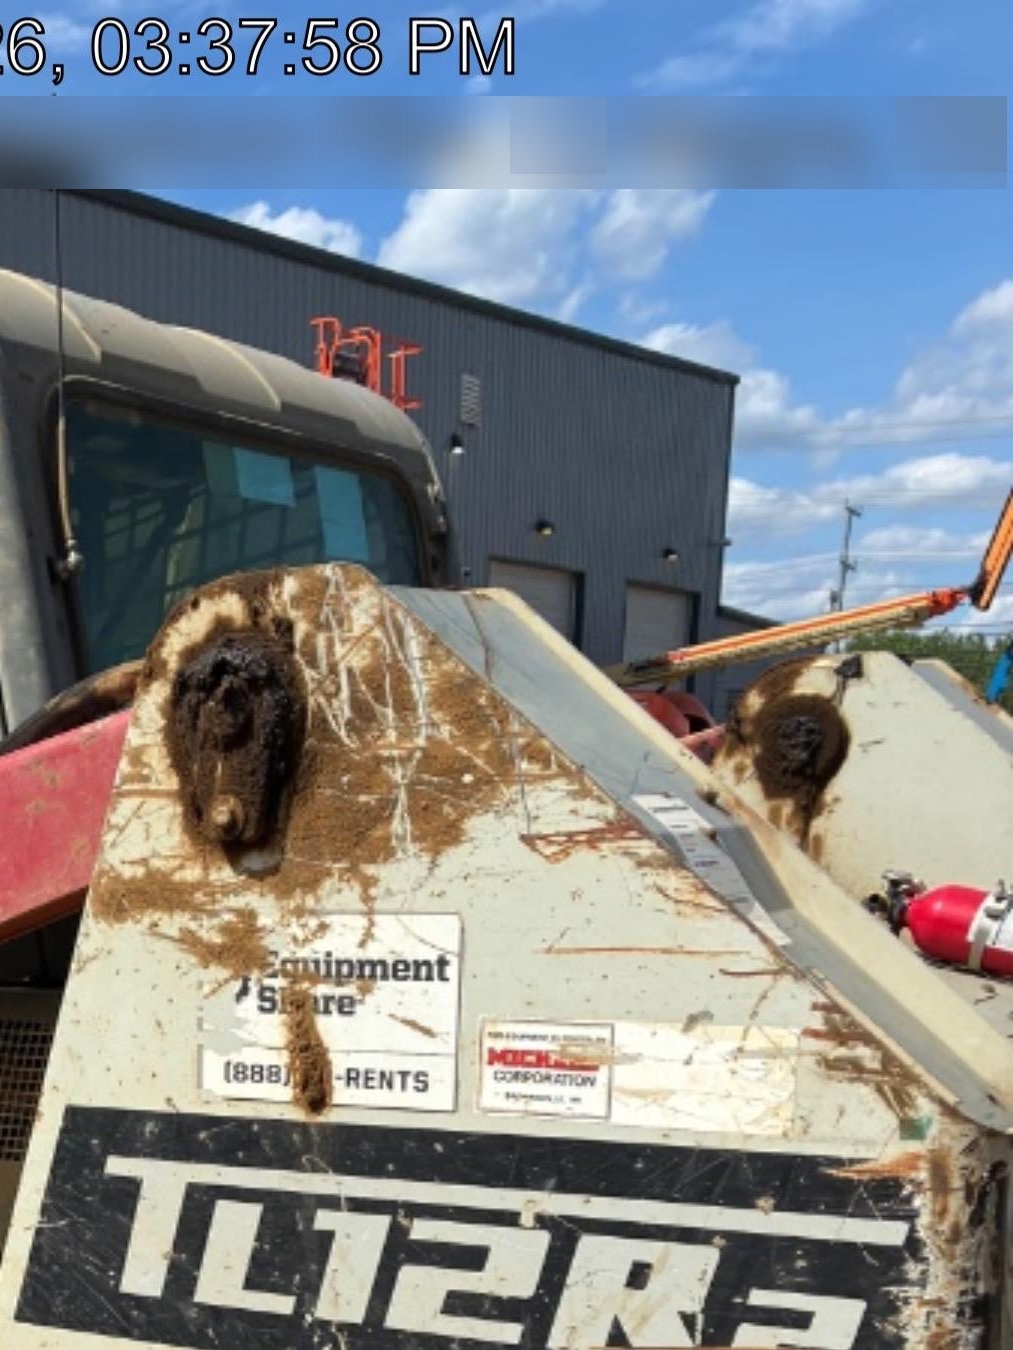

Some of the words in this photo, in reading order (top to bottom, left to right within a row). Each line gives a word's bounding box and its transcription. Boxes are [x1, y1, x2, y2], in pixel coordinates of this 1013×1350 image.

[257, 986, 356, 1015] Sre
[300, 1066, 430, 1094] -RENTS
[492, 1070, 598, 1088] CORPORATION
